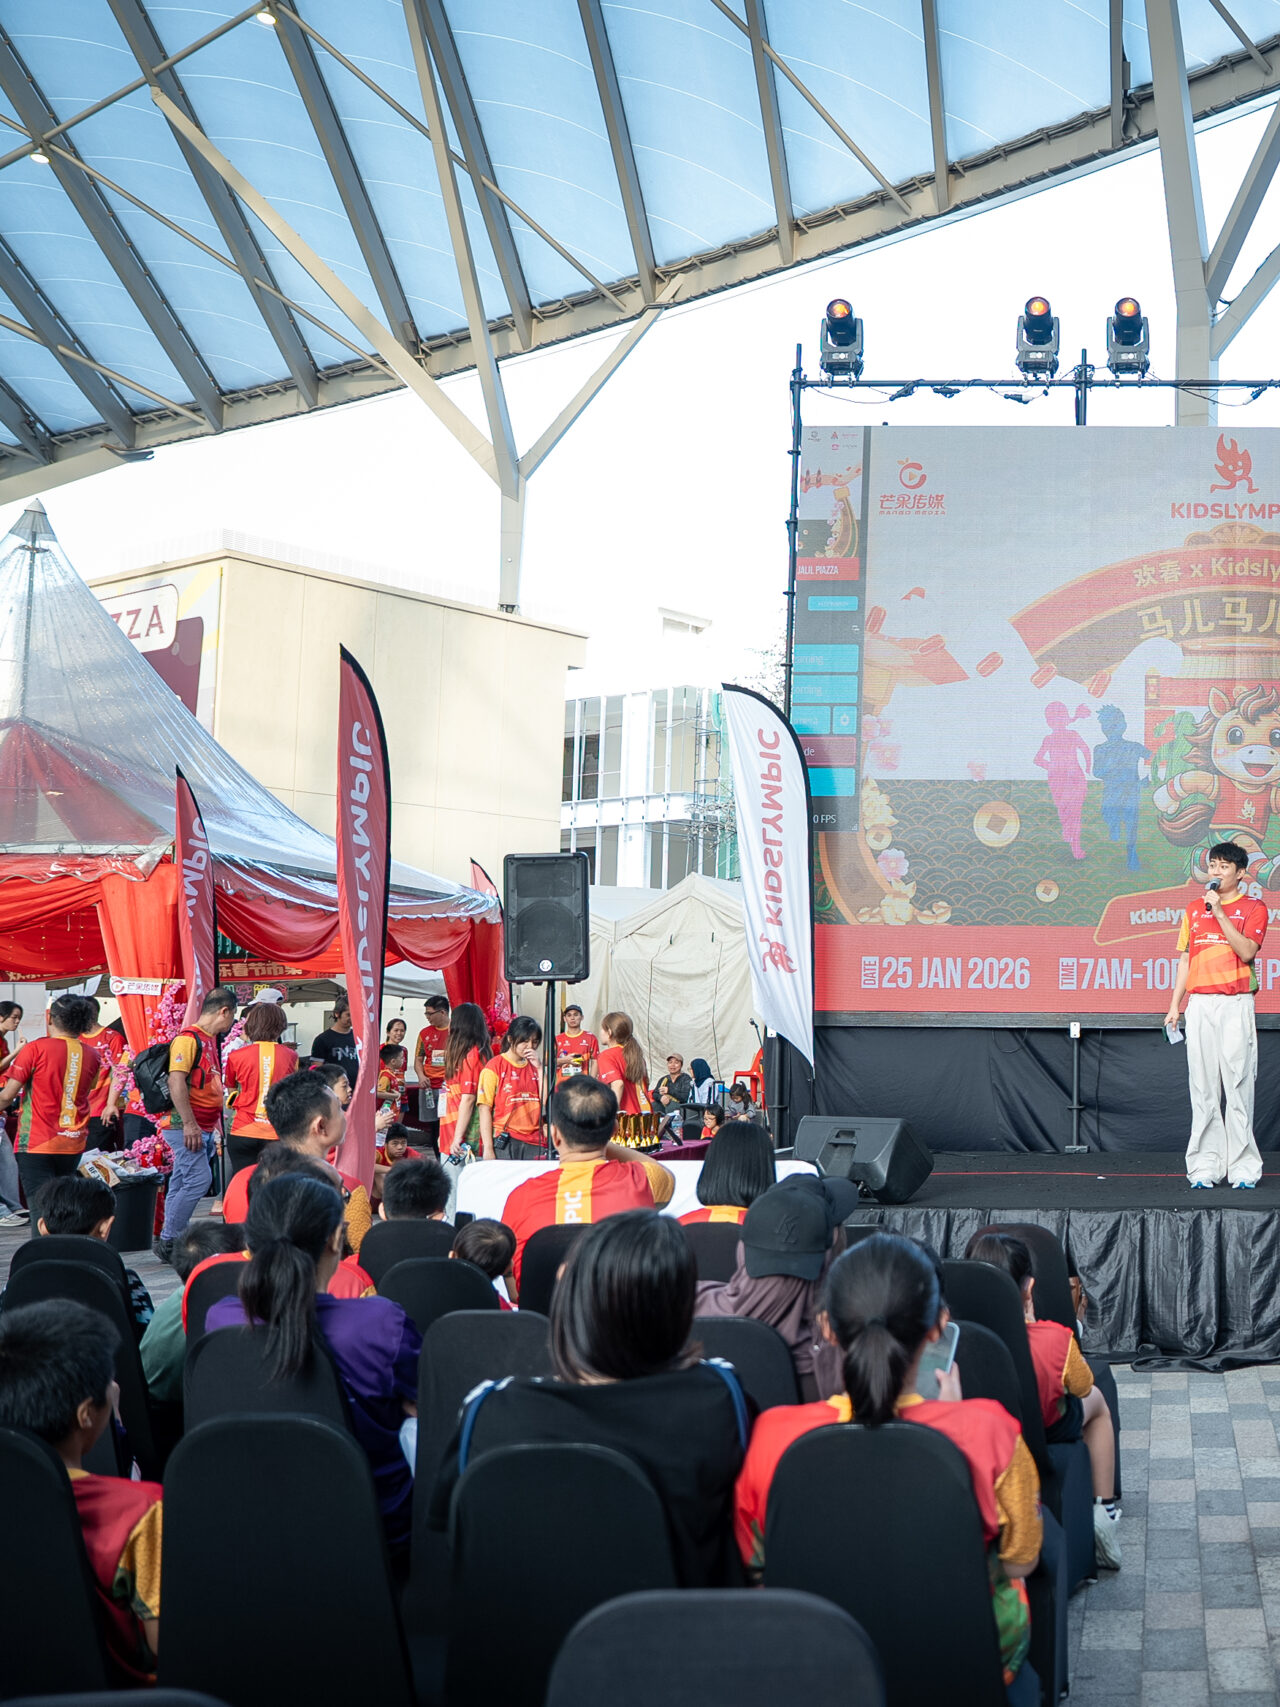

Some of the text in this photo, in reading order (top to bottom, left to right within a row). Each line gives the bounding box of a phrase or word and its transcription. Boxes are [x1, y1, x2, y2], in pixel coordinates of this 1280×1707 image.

[879, 493, 946, 509] 芒果传媒
[815, 565, 839, 575] PIAZZA
[1132, 559, 1181, 587] 欢春
[821, 815, 836, 824] FPS
[862, 959, 877, 986] DATE
[881, 956, 1031, 990] 25 JAN 2026
[1061, 960, 1076, 987] TIME
